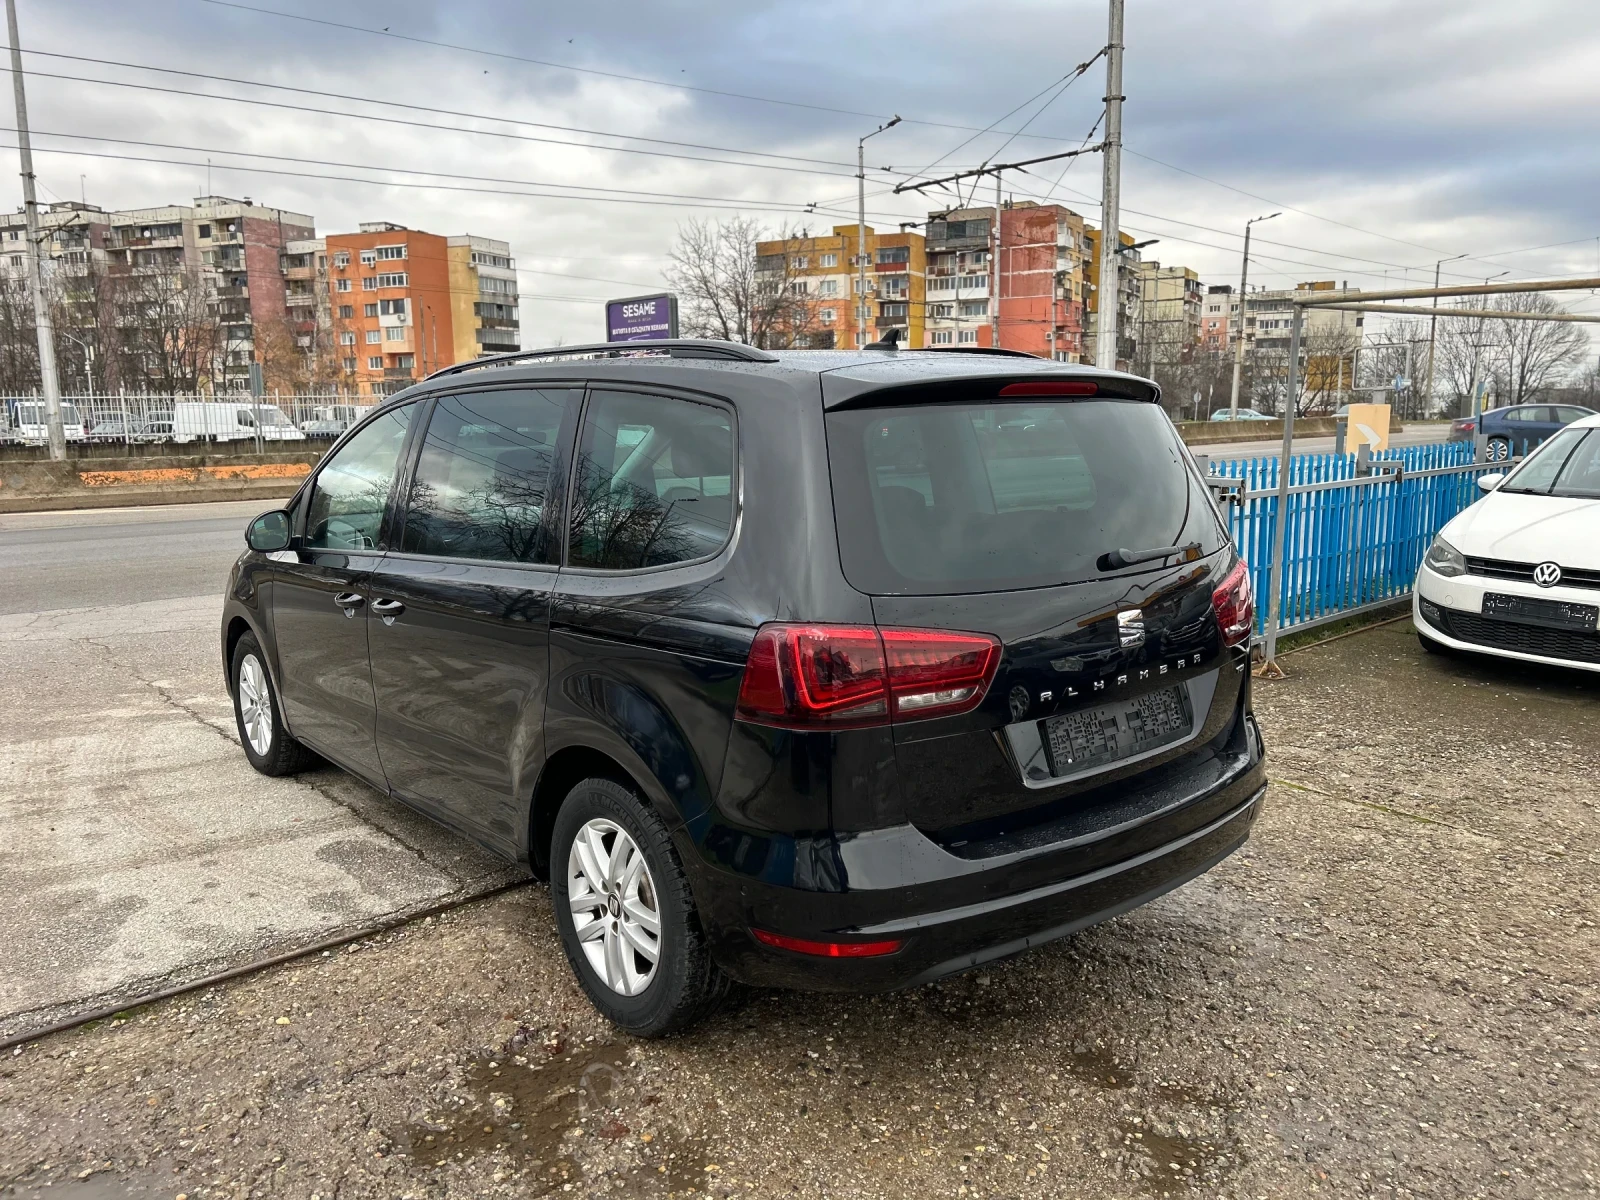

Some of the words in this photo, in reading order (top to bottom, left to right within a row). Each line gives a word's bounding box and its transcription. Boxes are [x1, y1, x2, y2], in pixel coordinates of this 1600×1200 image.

[623, 302, 655, 317] SESAME
[1040, 653, 1201, 702] ALHAMBRA
[601, 795, 649, 850] MICHELIN
